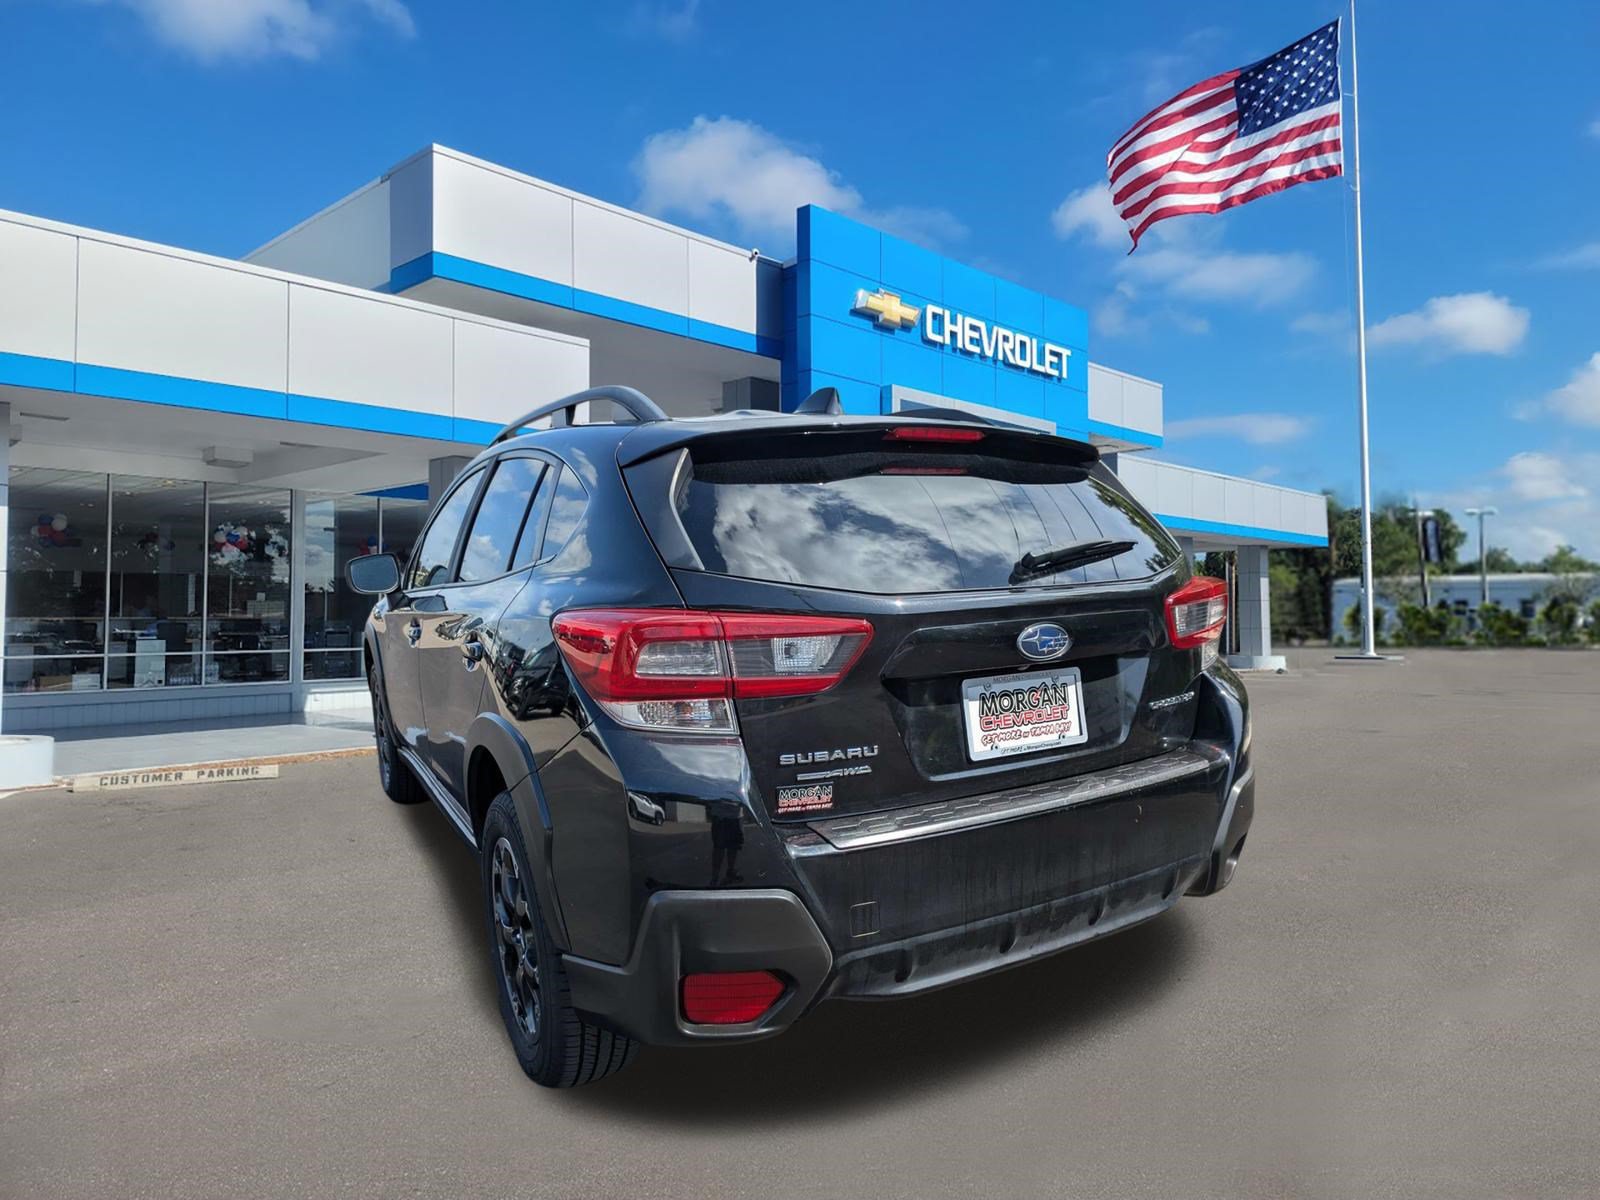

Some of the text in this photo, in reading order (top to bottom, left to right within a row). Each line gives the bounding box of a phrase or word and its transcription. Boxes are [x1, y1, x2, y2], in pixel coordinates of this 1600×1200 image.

[926, 304, 1072, 379] CHEVROLET
[979, 682, 1068, 718] MORGAN
[980, 705, 1069, 731] CHEVROLET
[780, 745, 879, 765] SUBARU
[100, 766, 259, 786] CUSTOMER PARKING
[779, 785, 832, 800] MORGAN
